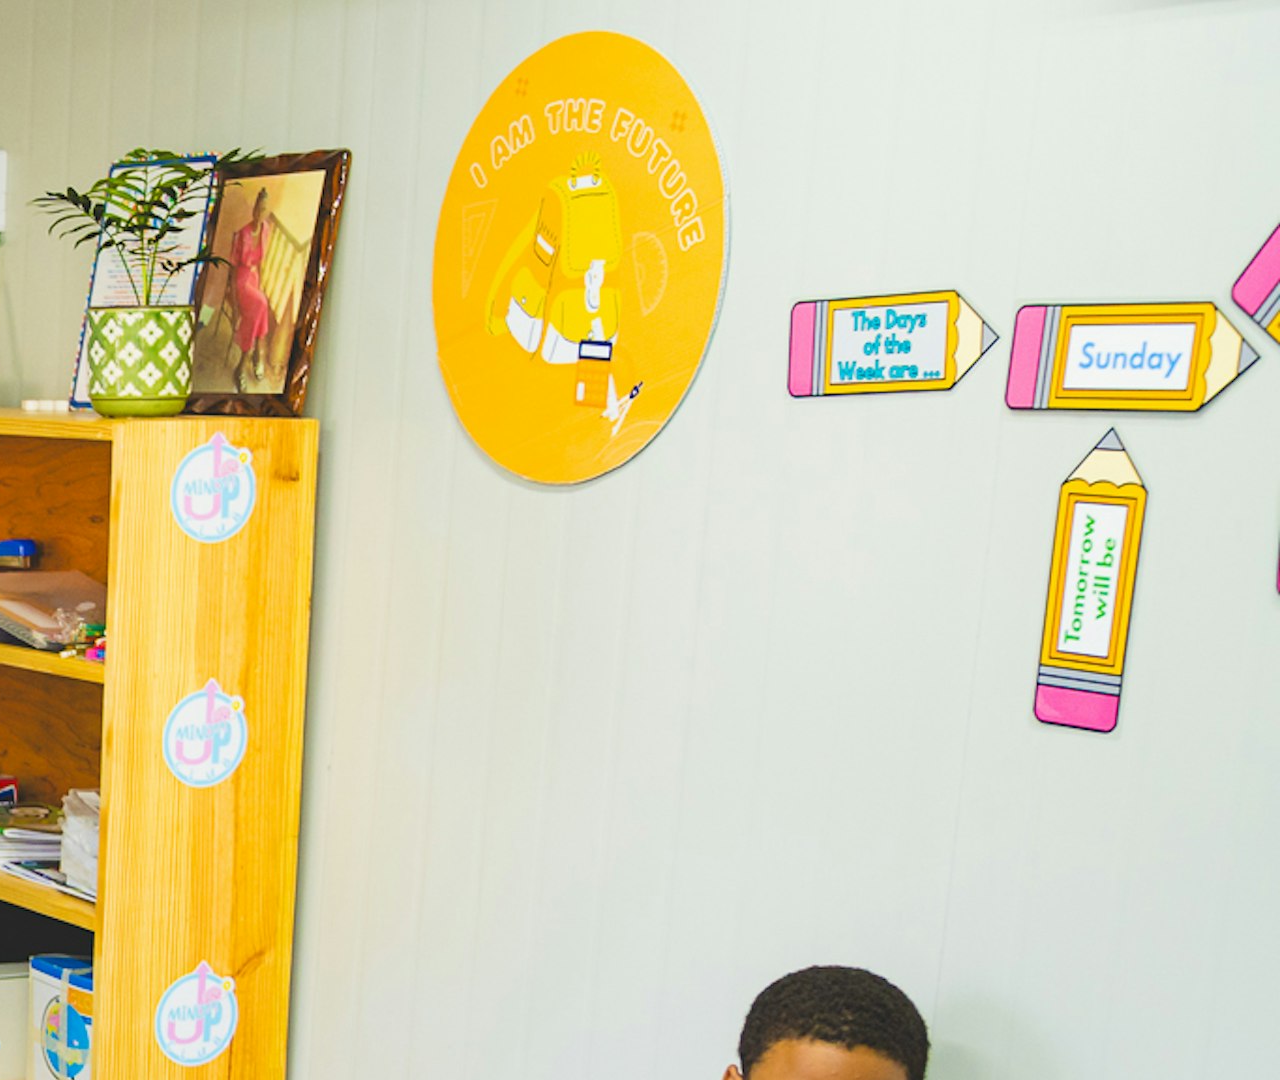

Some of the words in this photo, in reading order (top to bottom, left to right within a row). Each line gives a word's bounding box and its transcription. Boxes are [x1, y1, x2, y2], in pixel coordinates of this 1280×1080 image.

[469, 161, 488, 188] I
[490, 114, 535, 170] AM
[544, 97, 606, 135] THE
[610, 107, 705, 252] FUTURE
[851, 310, 881, 332] The
[884, 308, 928, 334] Days
[863, 333, 882, 356] of
[884, 333, 912, 355] the
[1078, 340, 1183, 379] Sunday
[837, 359, 886, 381] Week
[889, 363, 919, 380] are
[1096, 537, 1117, 567] be
[1064, 514, 1096, 644] Tomorrow
[1092, 575, 1111, 620] will
